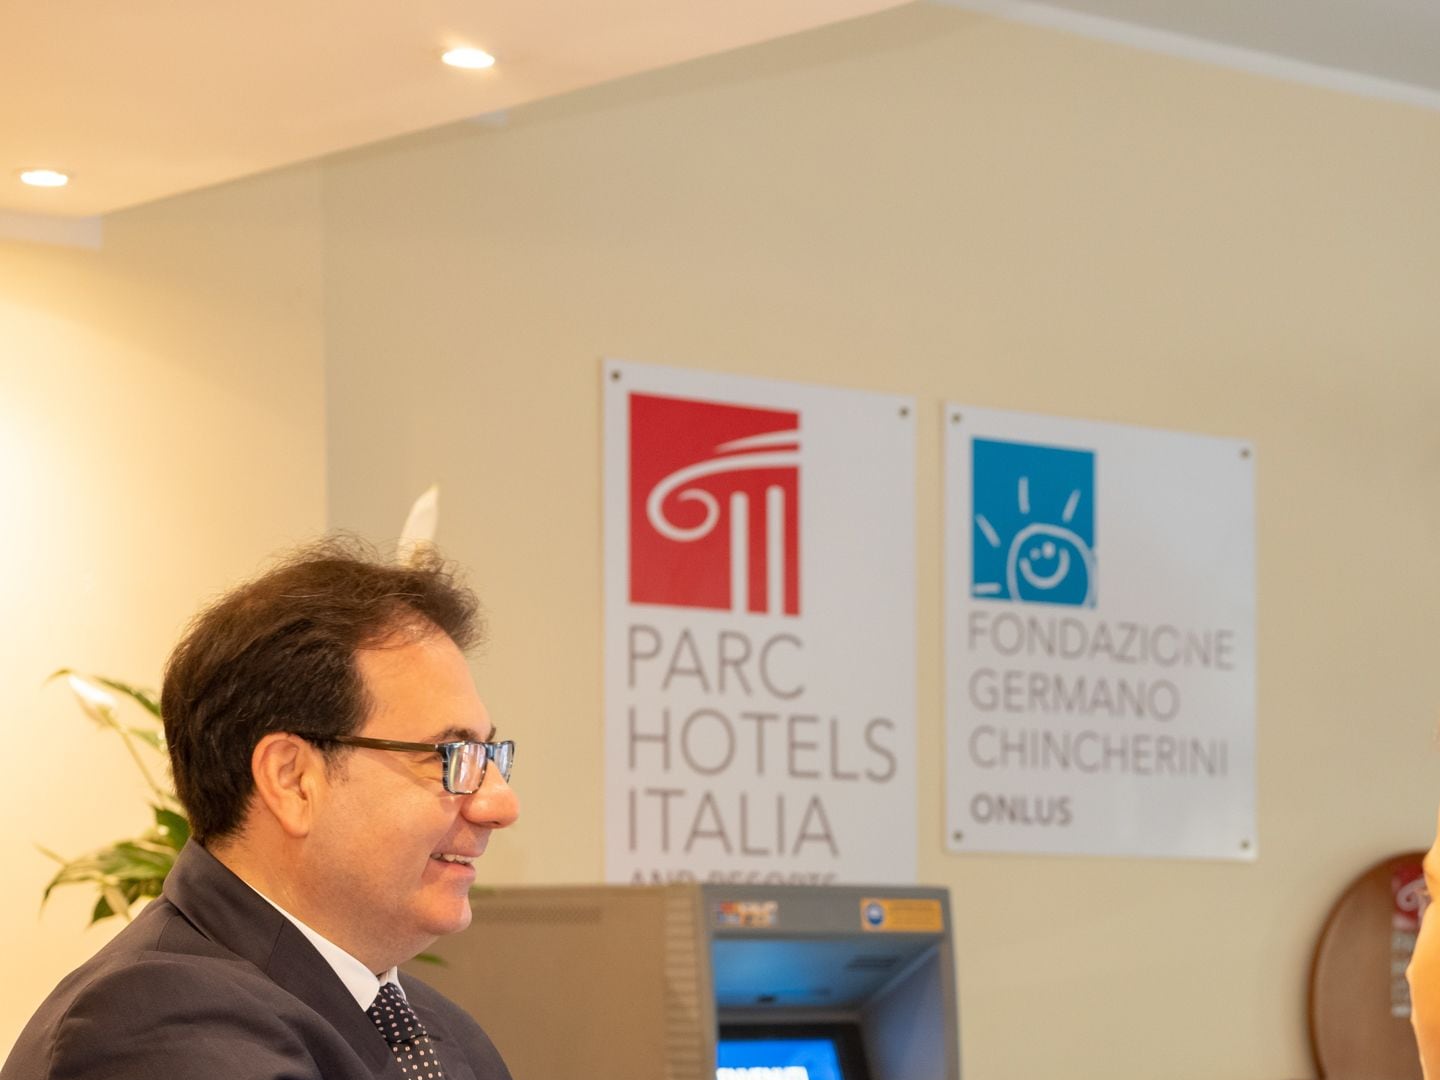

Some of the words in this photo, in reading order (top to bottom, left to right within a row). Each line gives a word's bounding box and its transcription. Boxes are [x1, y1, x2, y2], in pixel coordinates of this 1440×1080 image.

[627, 624, 805, 700] PARC
[967, 609, 1236, 671] FONDAZIONE
[968, 667, 1181, 723] GERMANO
[627, 706, 897, 784] HOTELS
[968, 725, 1229, 777] CHINCHERINI
[628, 788, 839, 857] ITALIA
[970, 793, 1073, 827] ONLUS
